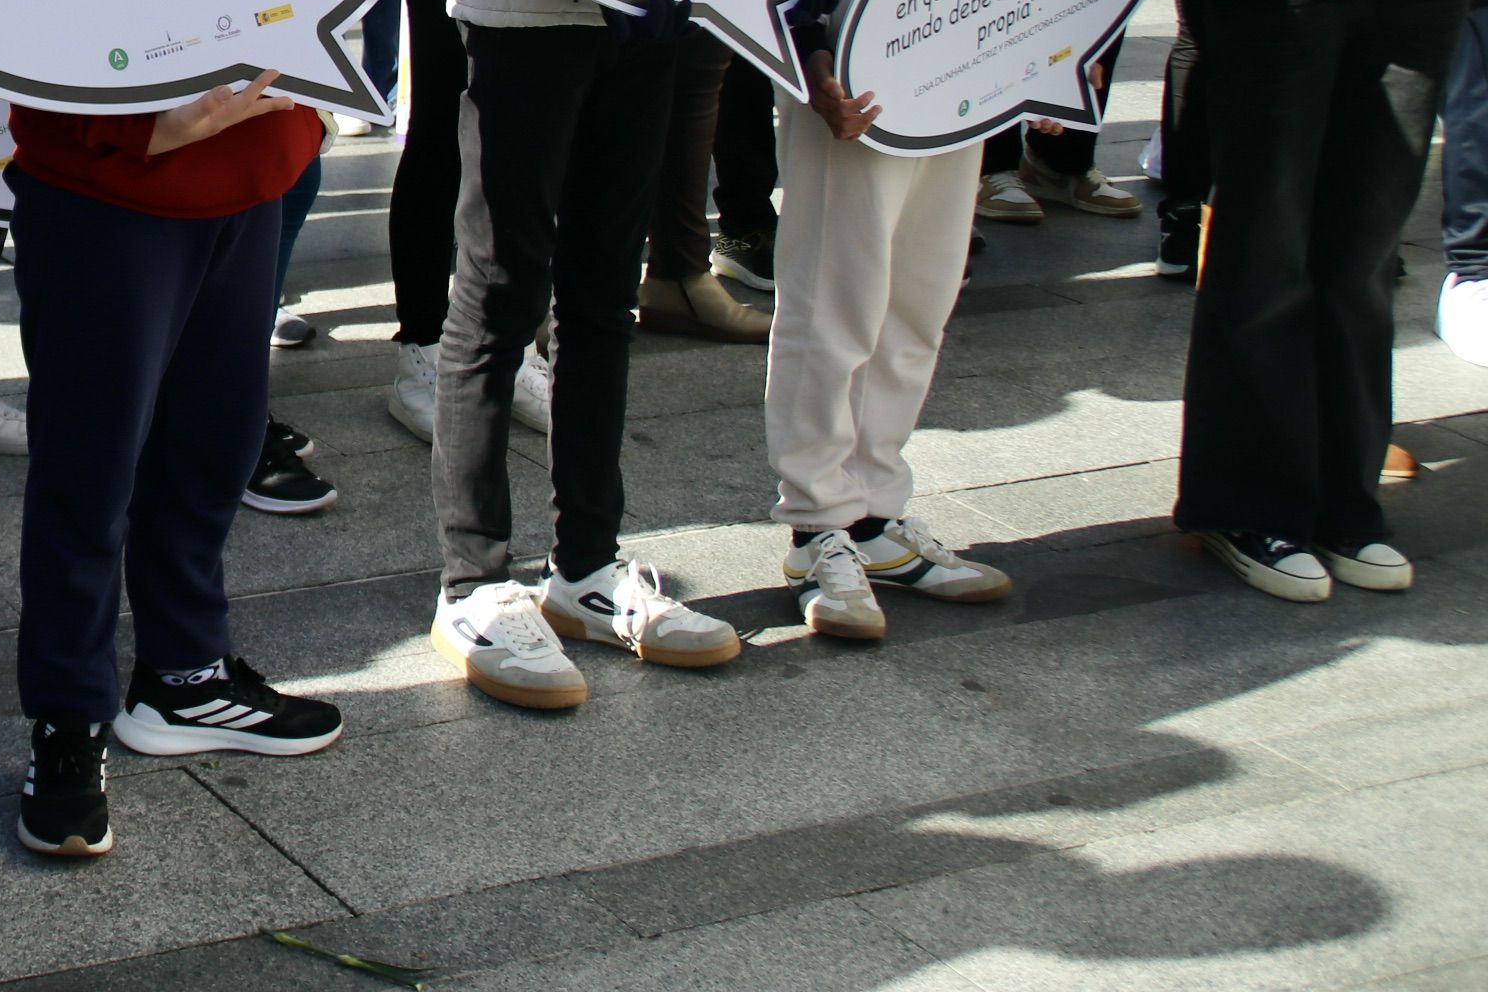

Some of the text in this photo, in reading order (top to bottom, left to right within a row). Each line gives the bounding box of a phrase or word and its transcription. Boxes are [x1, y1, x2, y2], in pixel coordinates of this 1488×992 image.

[886, 13, 942, 58] mundo
[914, 79, 935, 97] LENA
[971, 47, 998, 65] ACTRIZ
[1003, 20, 1054, 49] PRODUCTORA
